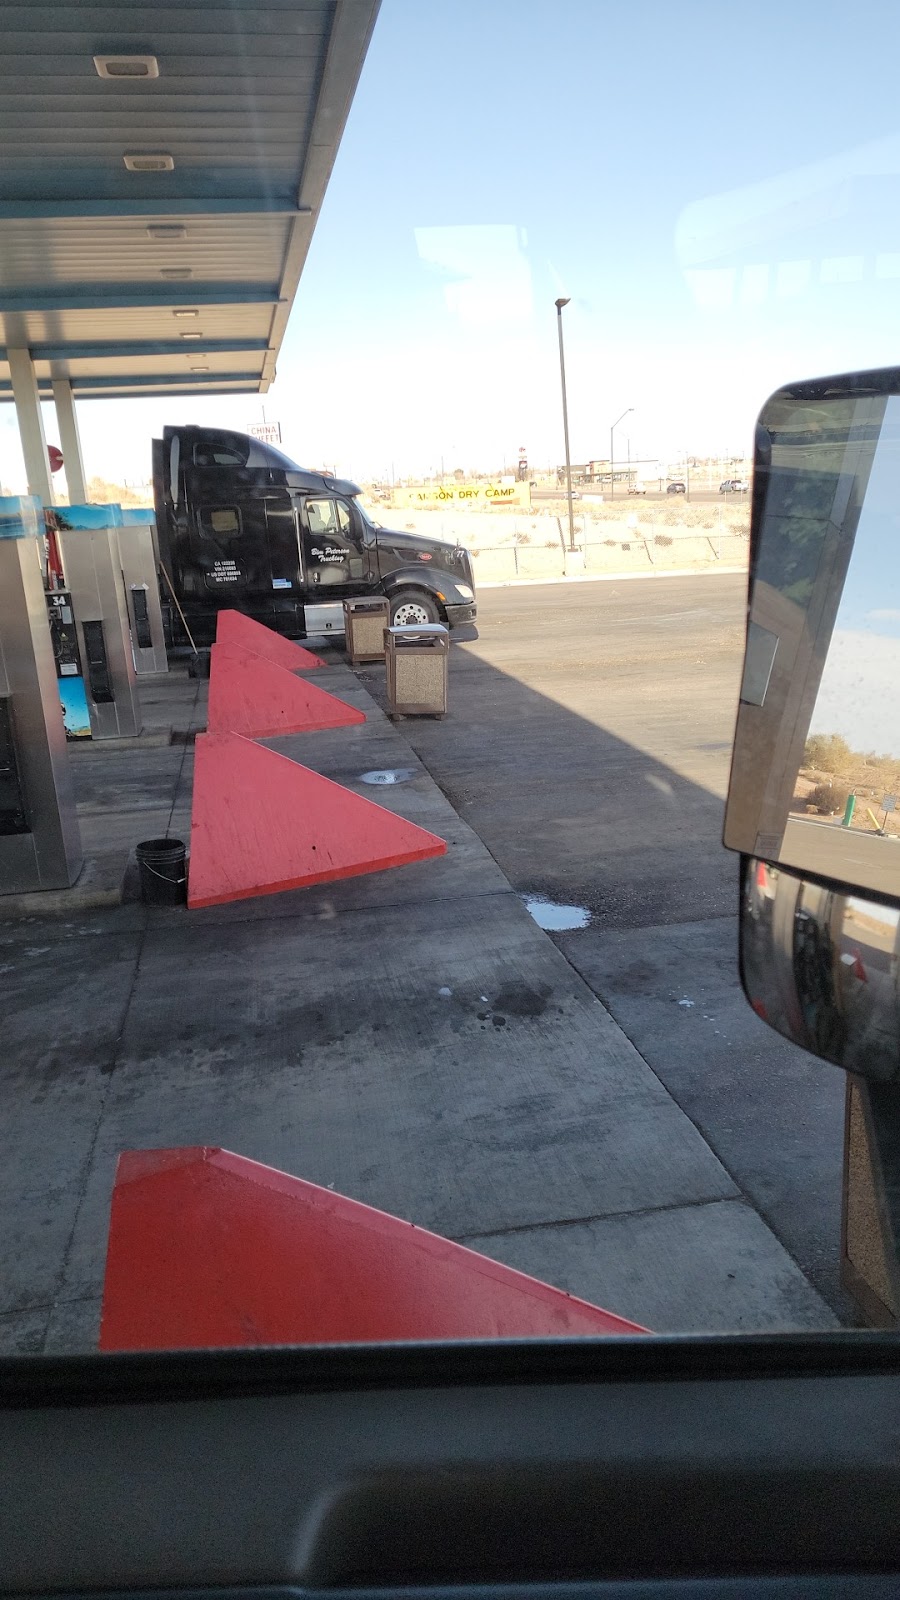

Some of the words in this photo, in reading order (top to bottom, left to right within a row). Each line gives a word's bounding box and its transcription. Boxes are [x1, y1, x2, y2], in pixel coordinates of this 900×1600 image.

[251, 426, 277, 435] CHINA
[256, 434, 278, 442] UFFET
[459, 490, 479, 499] DRY
[485, 488, 515, 497] CAMP
[318, 554, 344, 563] Trucking
[52, 596, 66, 606] 34
